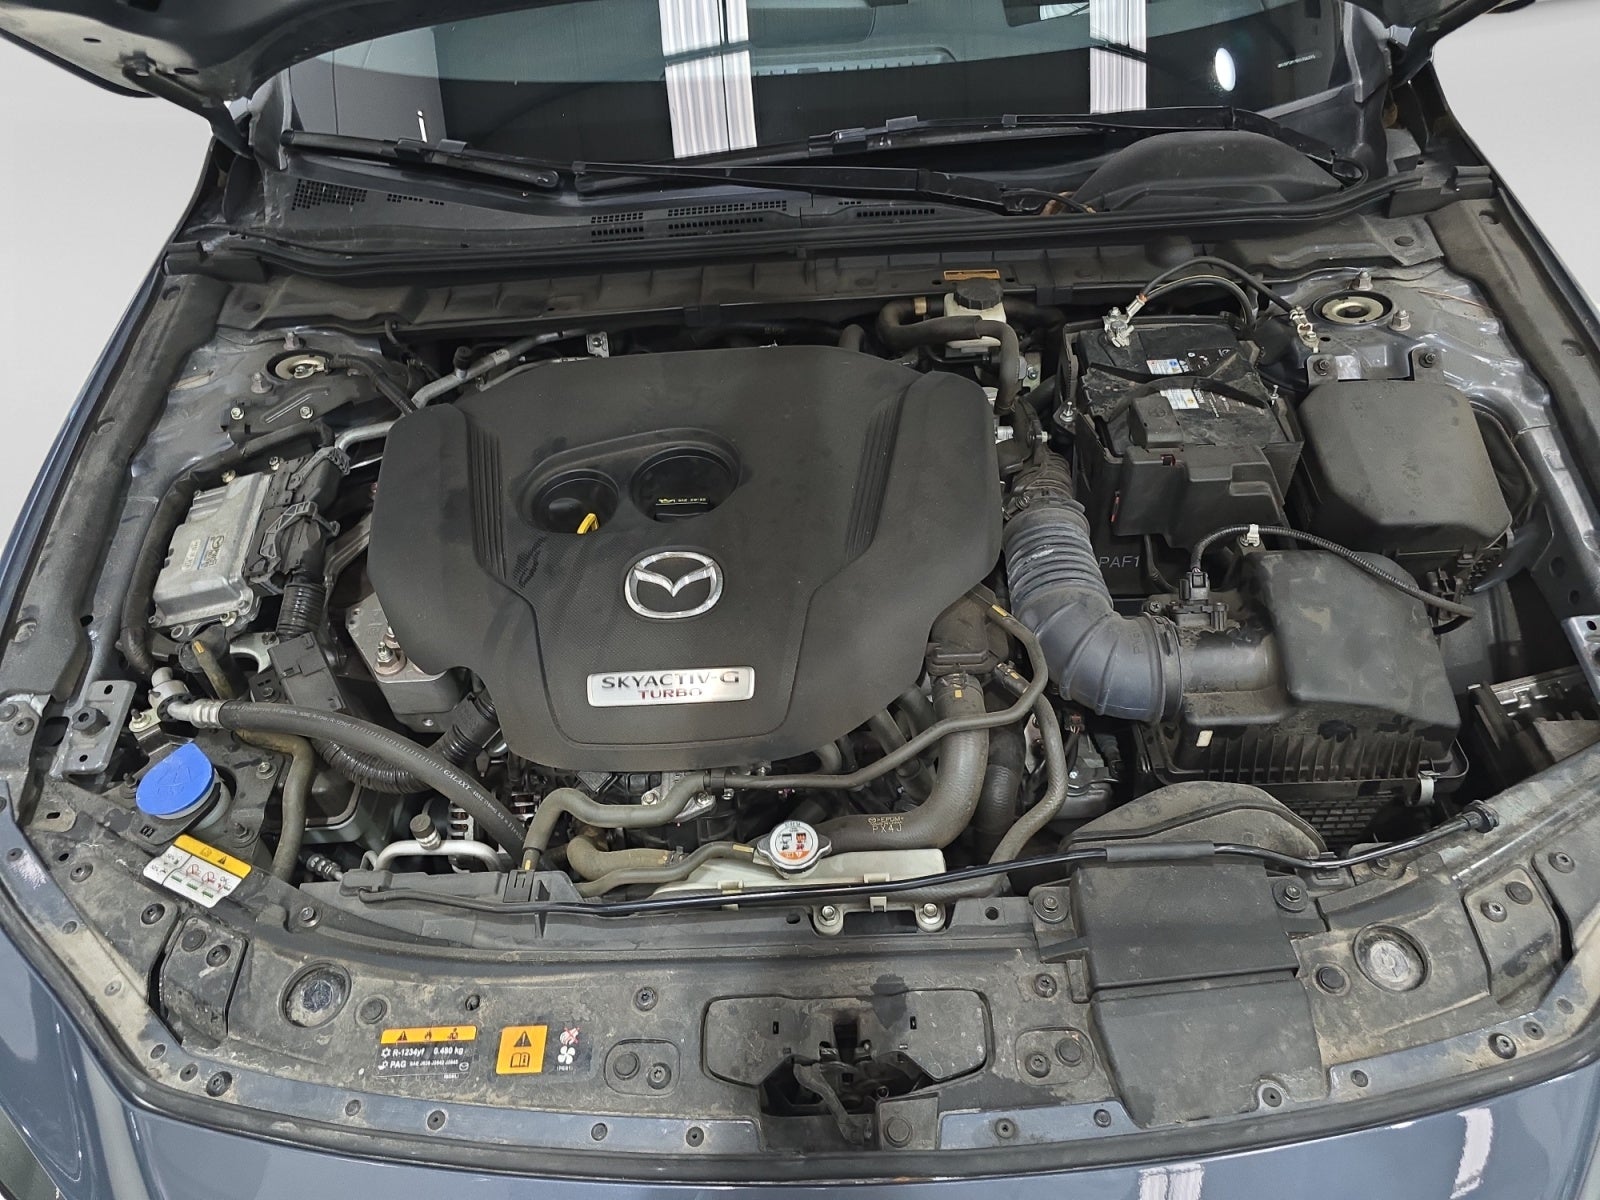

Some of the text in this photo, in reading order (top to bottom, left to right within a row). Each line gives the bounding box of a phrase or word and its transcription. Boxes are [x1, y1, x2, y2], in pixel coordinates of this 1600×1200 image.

[1098, 555, 1140, 568] PAF1
[601, 671, 740, 689] SKYACTIV-G
[639, 688, 703, 700] TURBO
[443, 769, 472, 790] GALAXY
[392, 1047, 425, 1057] R-1234yf
[390, 1060, 407, 1069] PAG
